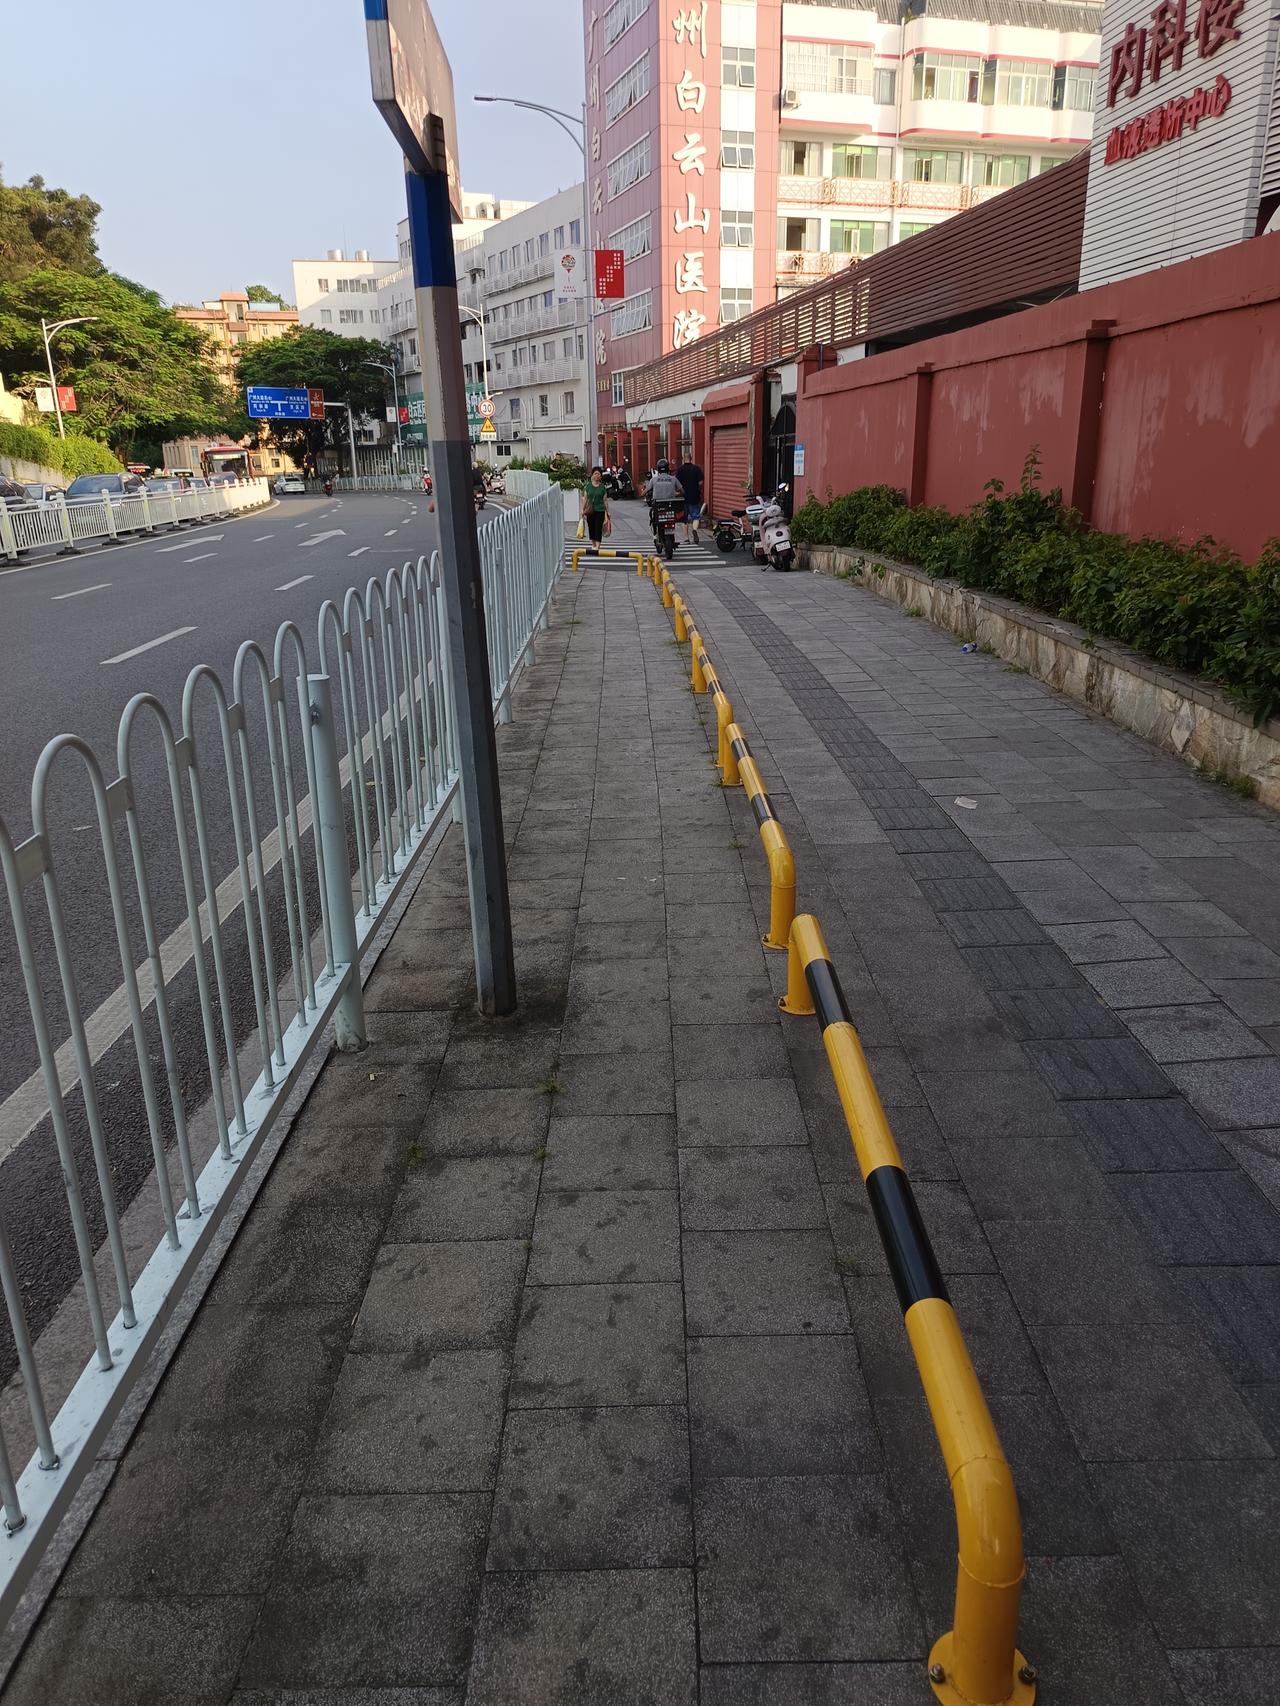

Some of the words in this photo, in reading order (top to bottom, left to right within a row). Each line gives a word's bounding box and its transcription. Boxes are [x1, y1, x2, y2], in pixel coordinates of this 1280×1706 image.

[1104, 73, 1232, 166] 血液透析中心
[672, 1, 711, 350] 州白云山医院
[483, 404, 492, 413] 30
